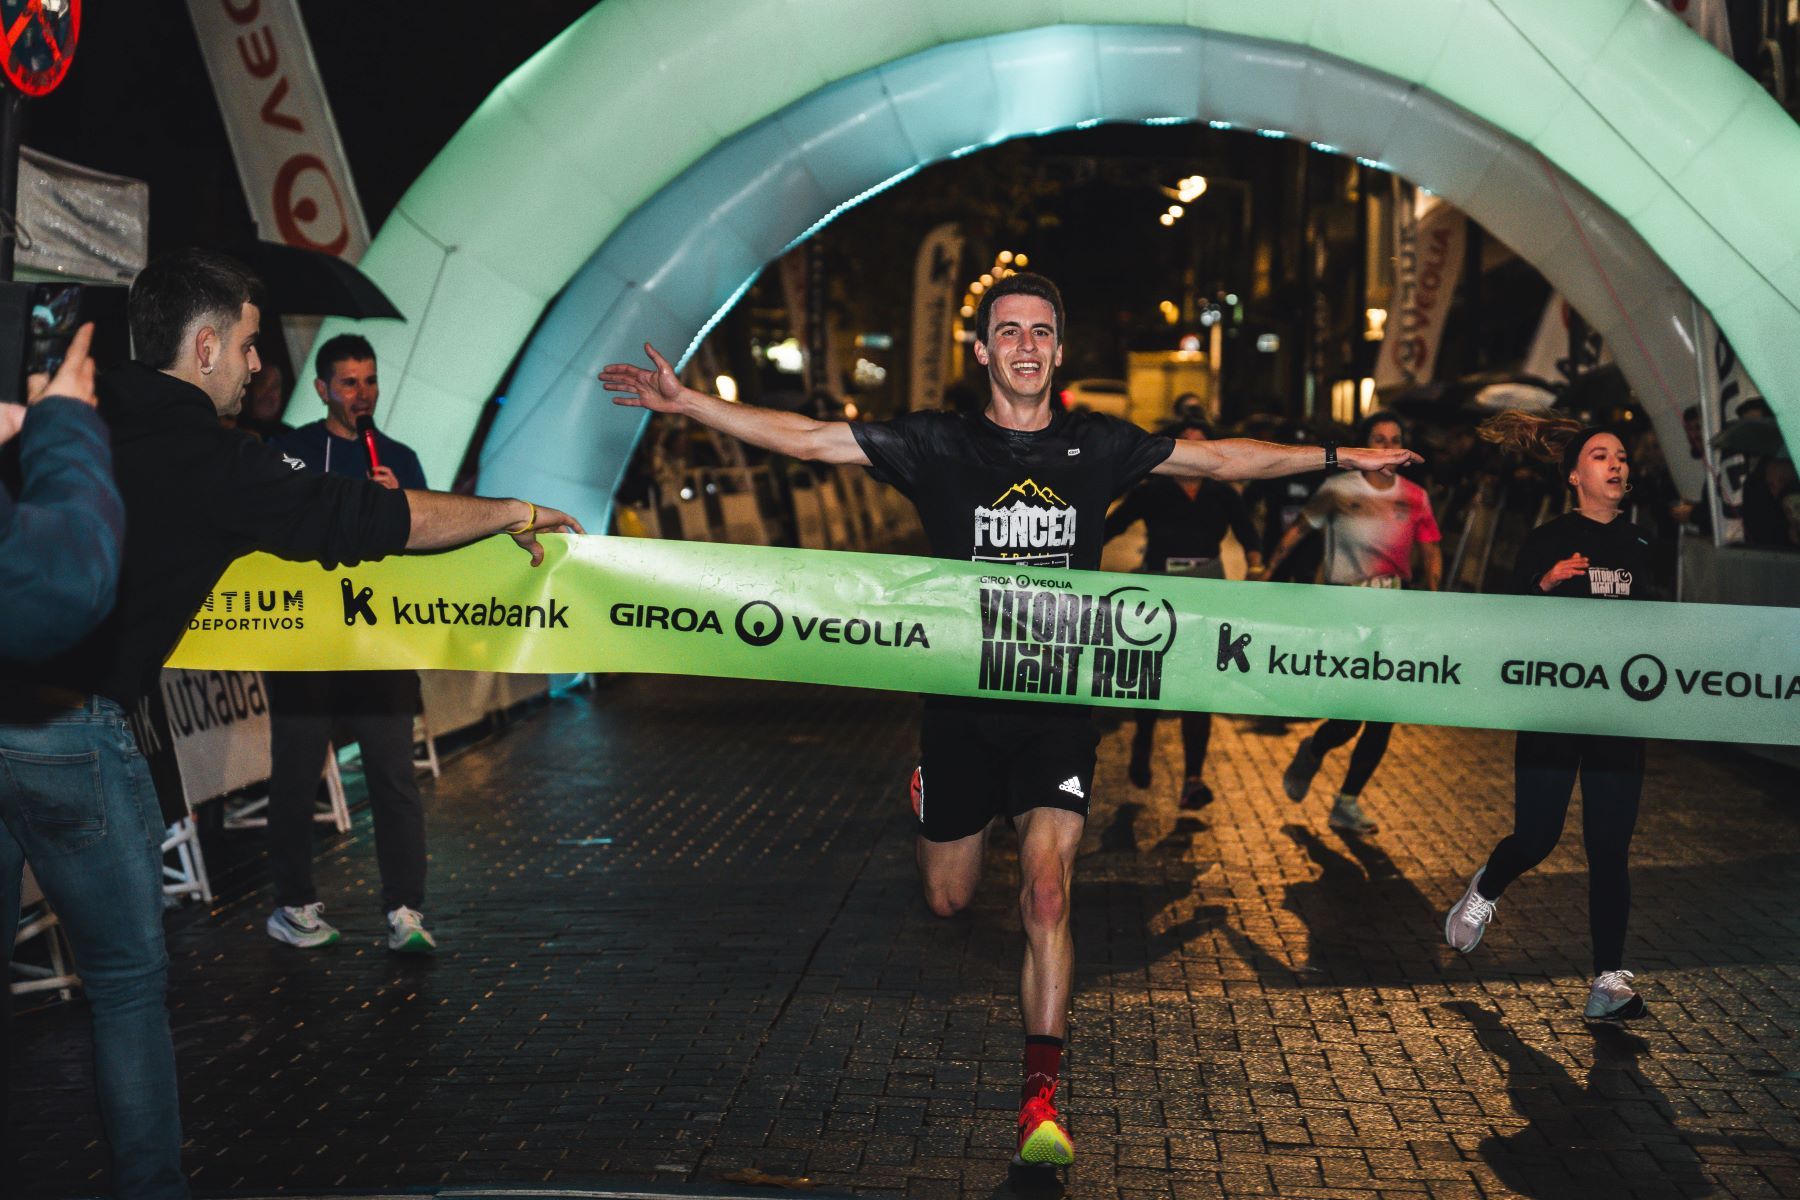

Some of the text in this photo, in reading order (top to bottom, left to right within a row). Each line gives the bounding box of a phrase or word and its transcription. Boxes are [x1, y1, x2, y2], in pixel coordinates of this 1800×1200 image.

[974, 499, 1077, 548] FONCEA
[980, 575, 1073, 589] GIROA VEOLIA
[188, 617, 304, 631] DEPORTIVOS
[392, 596, 570, 629] kutxabank
[609, 602, 931, 649] GIROA VEOLIA
[979, 588, 1114, 647] VITORIA
[978, 640, 1164, 701] NIGHT RUN
[1268, 644, 1463, 685] kutxabank
[1500, 659, 1800, 700] GIROA VEOLIA
[167, 669, 267, 739] utxaba
